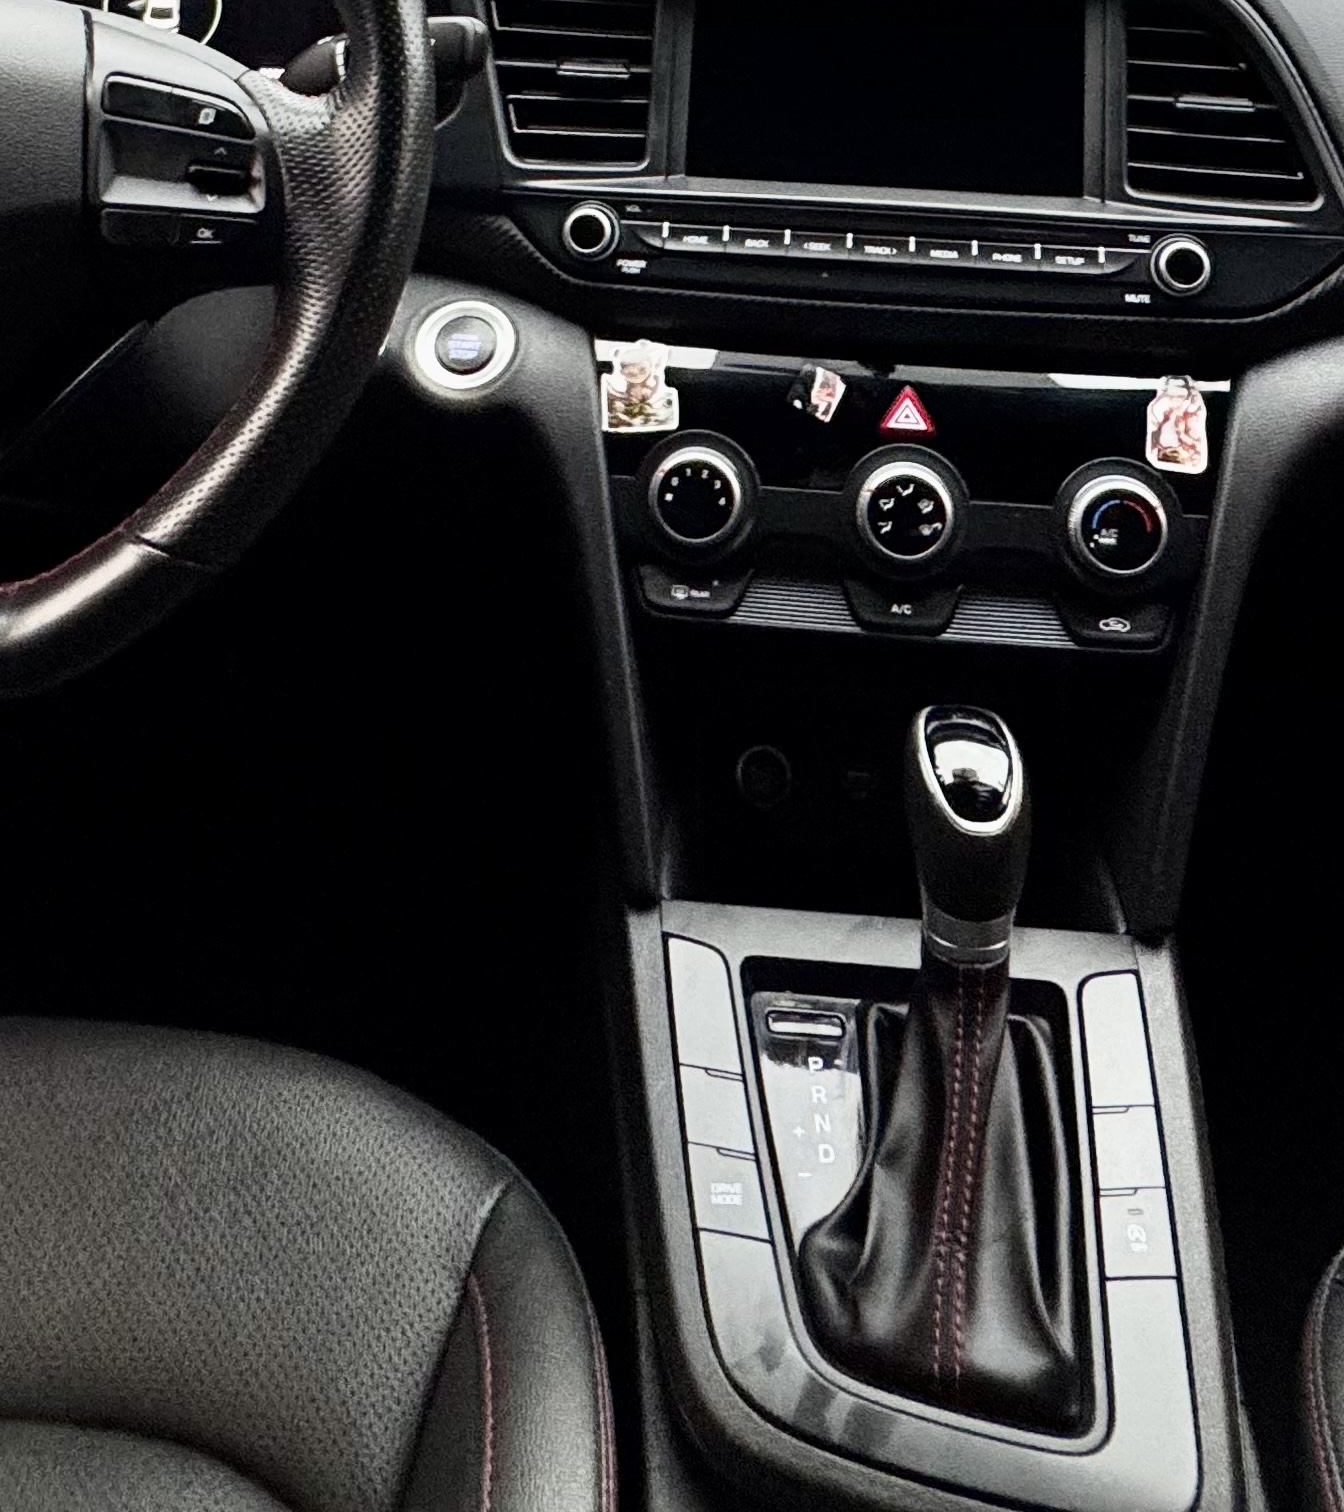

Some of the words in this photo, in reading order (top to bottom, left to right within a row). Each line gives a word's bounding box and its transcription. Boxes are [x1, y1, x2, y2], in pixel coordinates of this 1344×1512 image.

[890, 603, 912, 615] A/C
[808, 1056, 824, 1074] P
[811, 1085, 828, 1104] R
[814, 1113, 832, 1133] N
[818, 1143, 836, 1164] D
